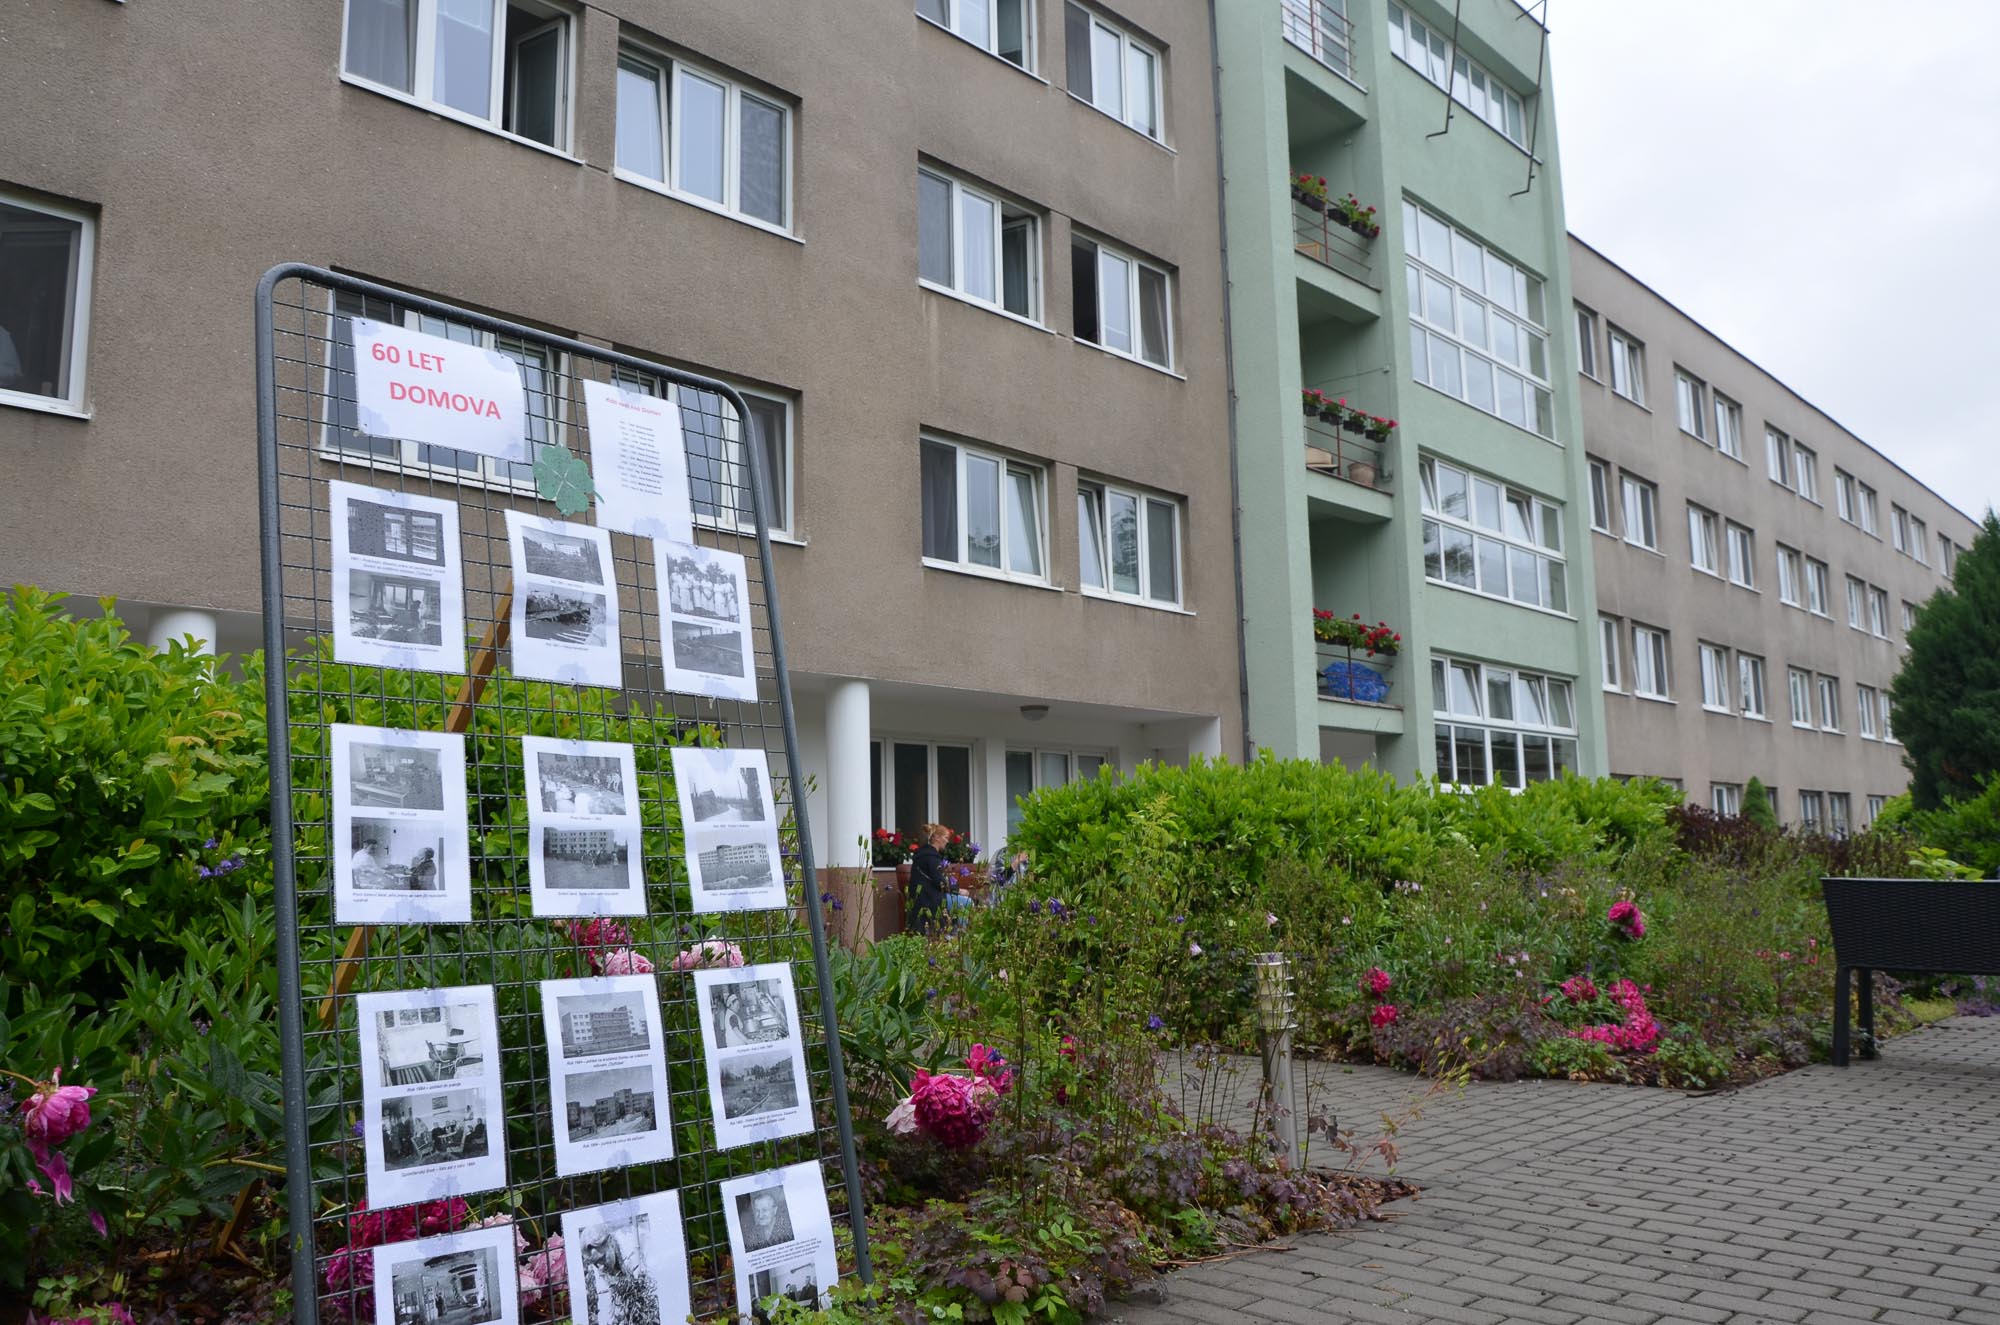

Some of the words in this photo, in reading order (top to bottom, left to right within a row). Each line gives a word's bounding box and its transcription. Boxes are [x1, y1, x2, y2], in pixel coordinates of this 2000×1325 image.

[372, 343, 400, 364] 60
[408, 349, 445, 373] LET
[390, 381, 501, 420] DOMOVA
